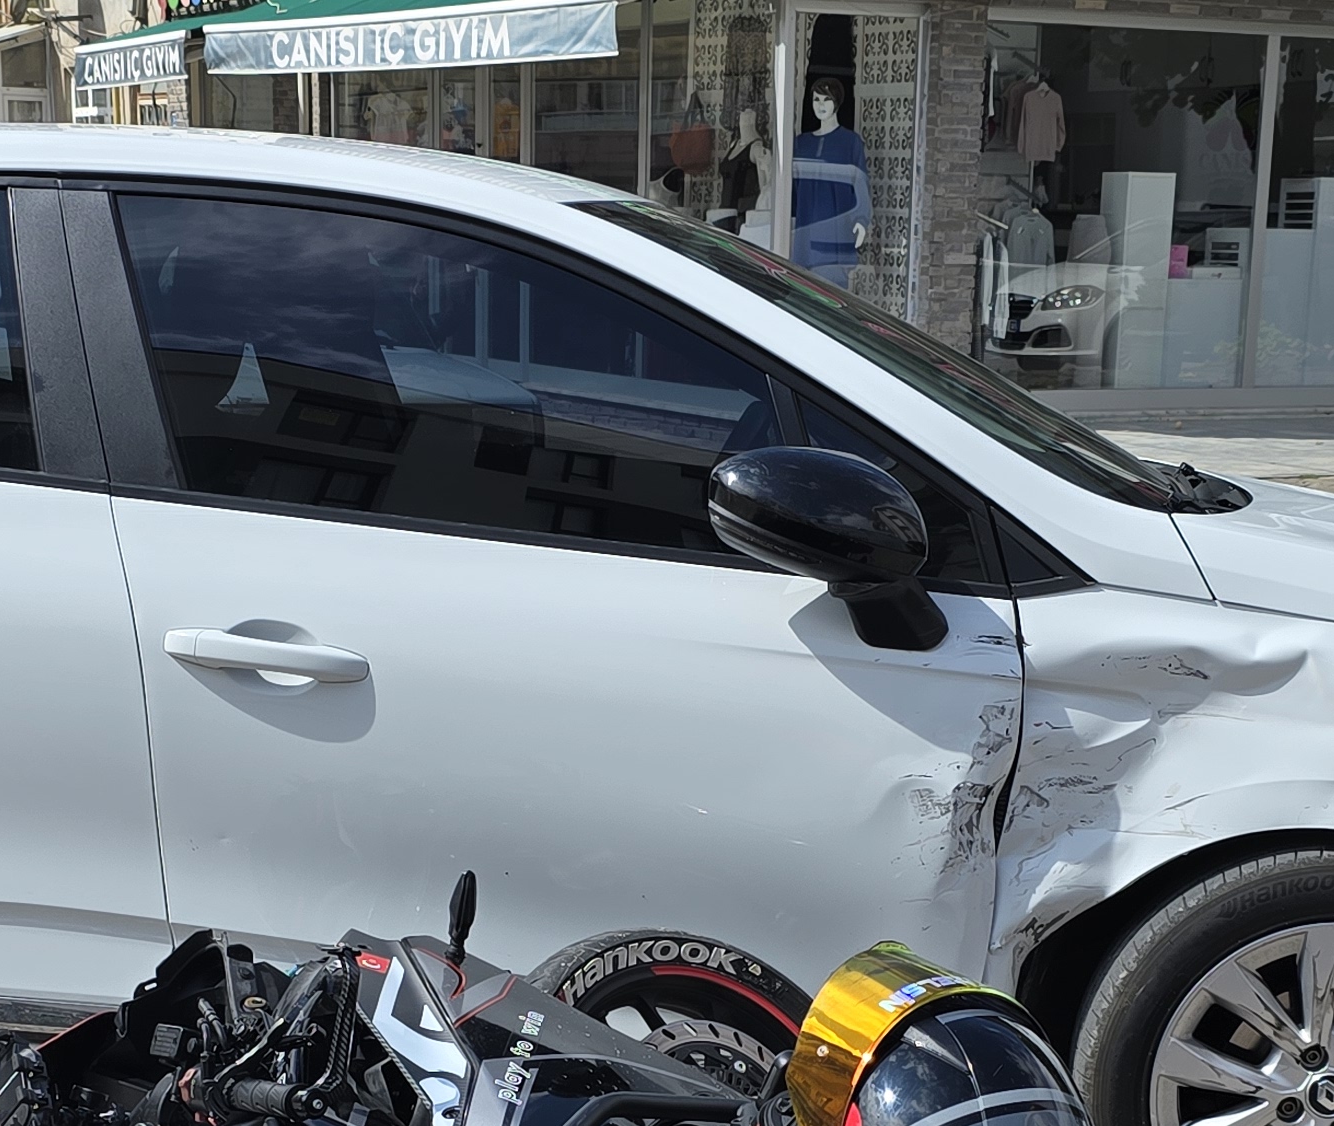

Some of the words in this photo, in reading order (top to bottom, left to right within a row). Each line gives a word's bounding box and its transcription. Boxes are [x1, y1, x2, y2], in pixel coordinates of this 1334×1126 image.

[272, 26, 363, 68] CANISI
[84, 51, 124, 84] CANISI
[518, 1010, 545, 1036] win
[509, 1040, 534, 1058] to
[494, 1061, 531, 1106] play
